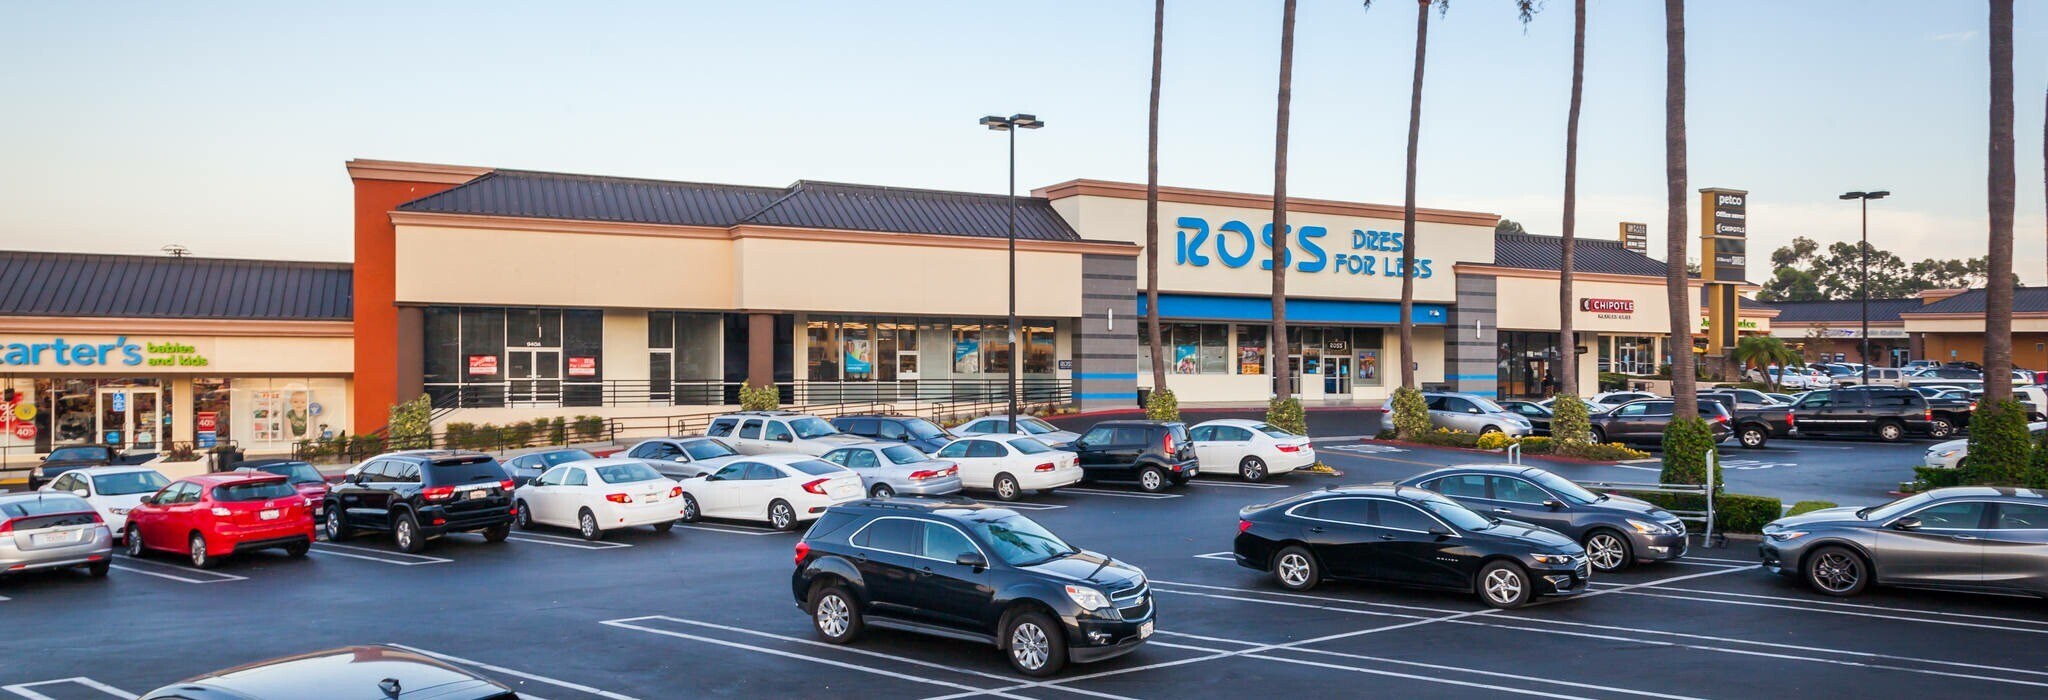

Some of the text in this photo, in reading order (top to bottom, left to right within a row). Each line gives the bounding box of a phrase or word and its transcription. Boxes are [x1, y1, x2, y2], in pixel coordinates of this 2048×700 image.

[1719, 195, 1743, 206] petco
[1177, 217, 1327, 272] ROSS
[1352, 229, 1405, 252] DRES
[1334, 254, 1376, 276] FOR
[1593, 300, 1634, 311] CHIPOTLE
[0, 336, 143, 367] arter's
[147, 341, 195, 354] babies
[147, 355, 208, 367] and kids
